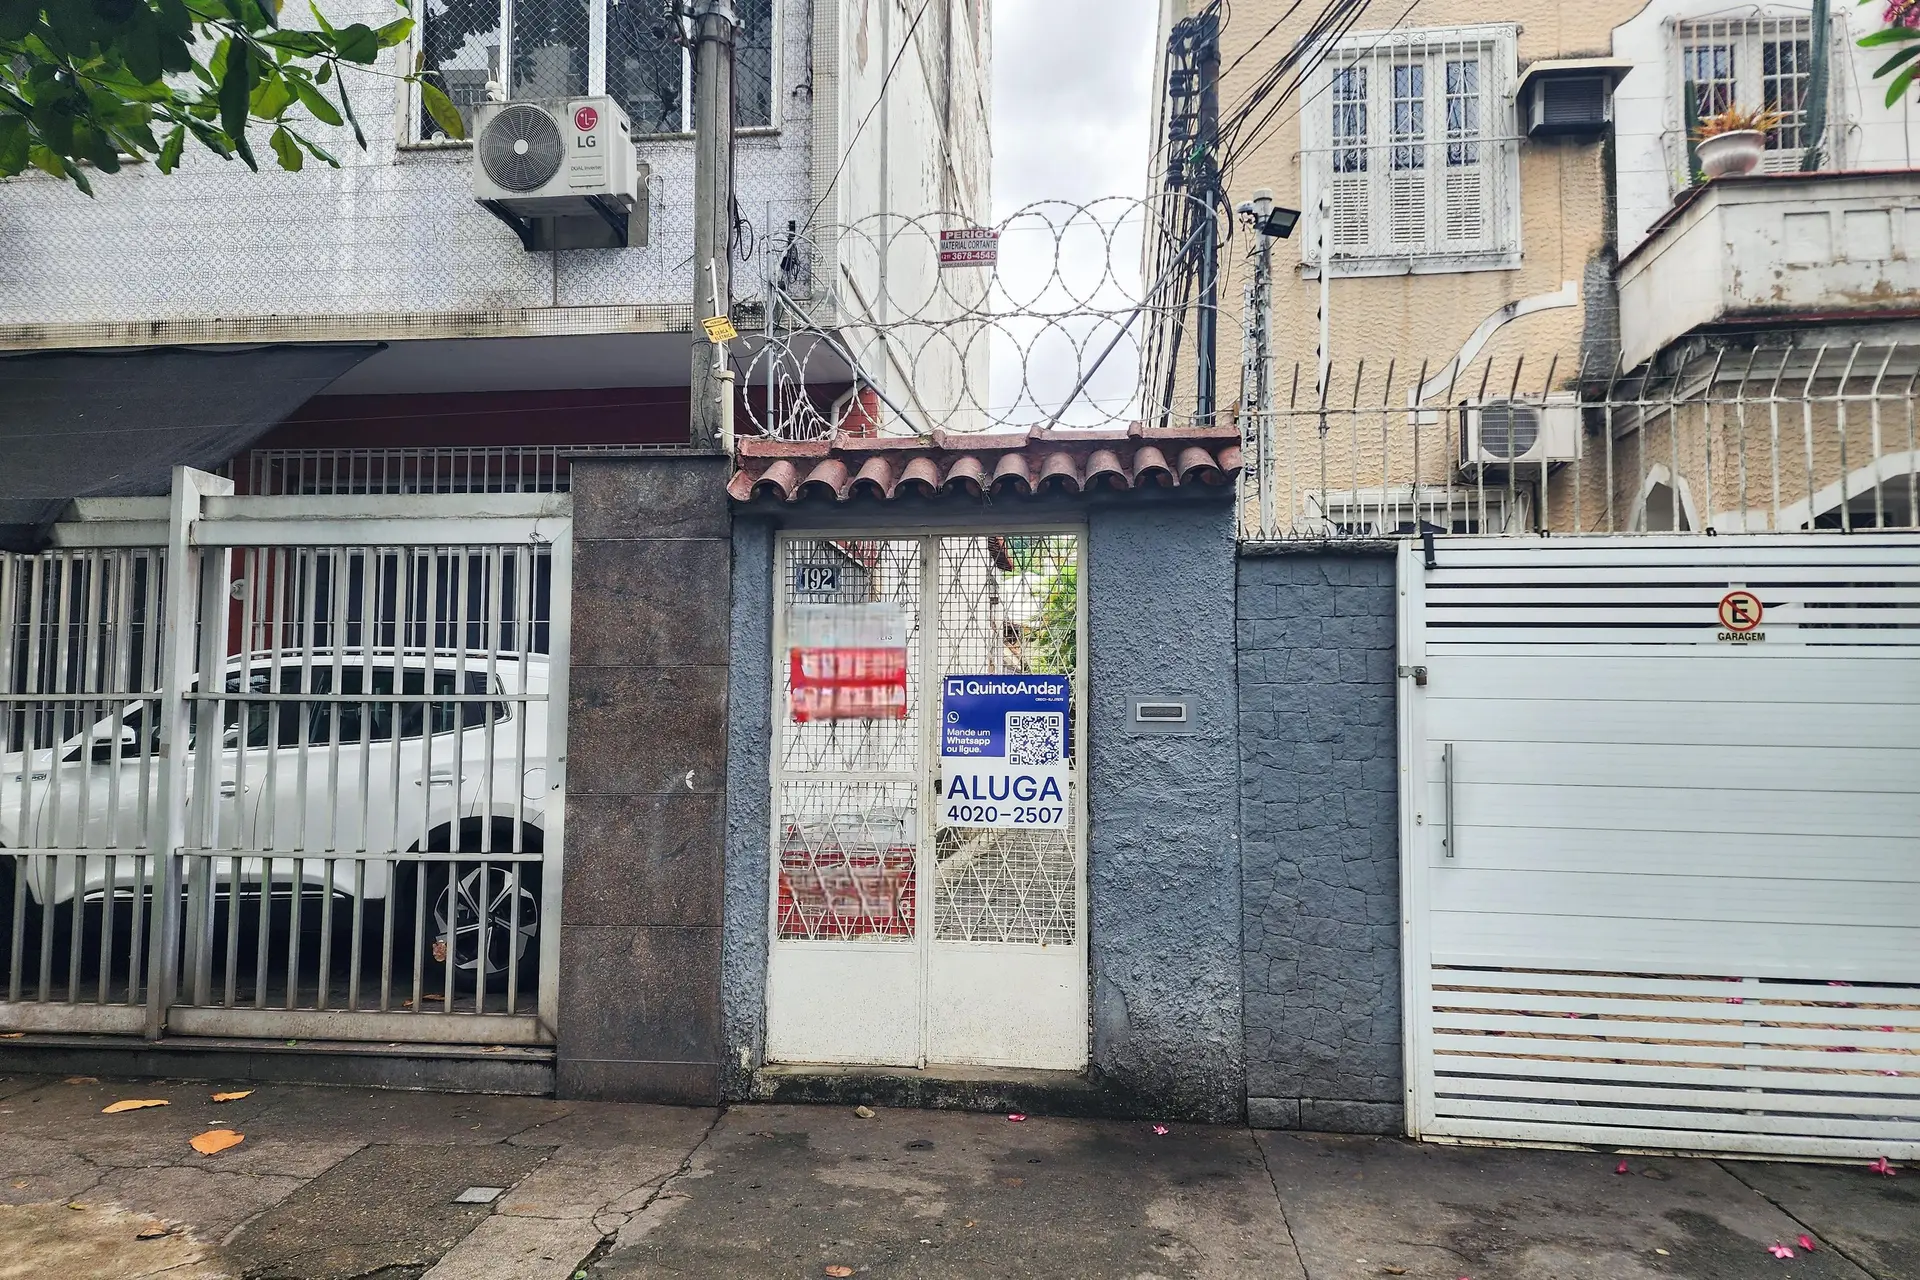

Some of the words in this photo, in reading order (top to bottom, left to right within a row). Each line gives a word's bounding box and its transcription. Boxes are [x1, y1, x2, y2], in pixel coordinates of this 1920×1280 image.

[577, 135, 596, 148] LG
[945, 230, 994, 239] PERIGO
[941, 241, 966, 250] MATERIAL
[967, 240, 997, 249] CORTANTE
[951, 251, 996, 260] 3678-4545
[802, 567, 832, 590] 192
[1717, 632, 1766, 641] GARAGEM
[966, 681, 1064, 695] QuintoAndar
[946, 737, 991, 746] Whatsapp
[959, 745, 982, 755] ligue.
[947, 775, 1063, 802] ALUGA
[947, 805, 1063, 824] 4020-2507
